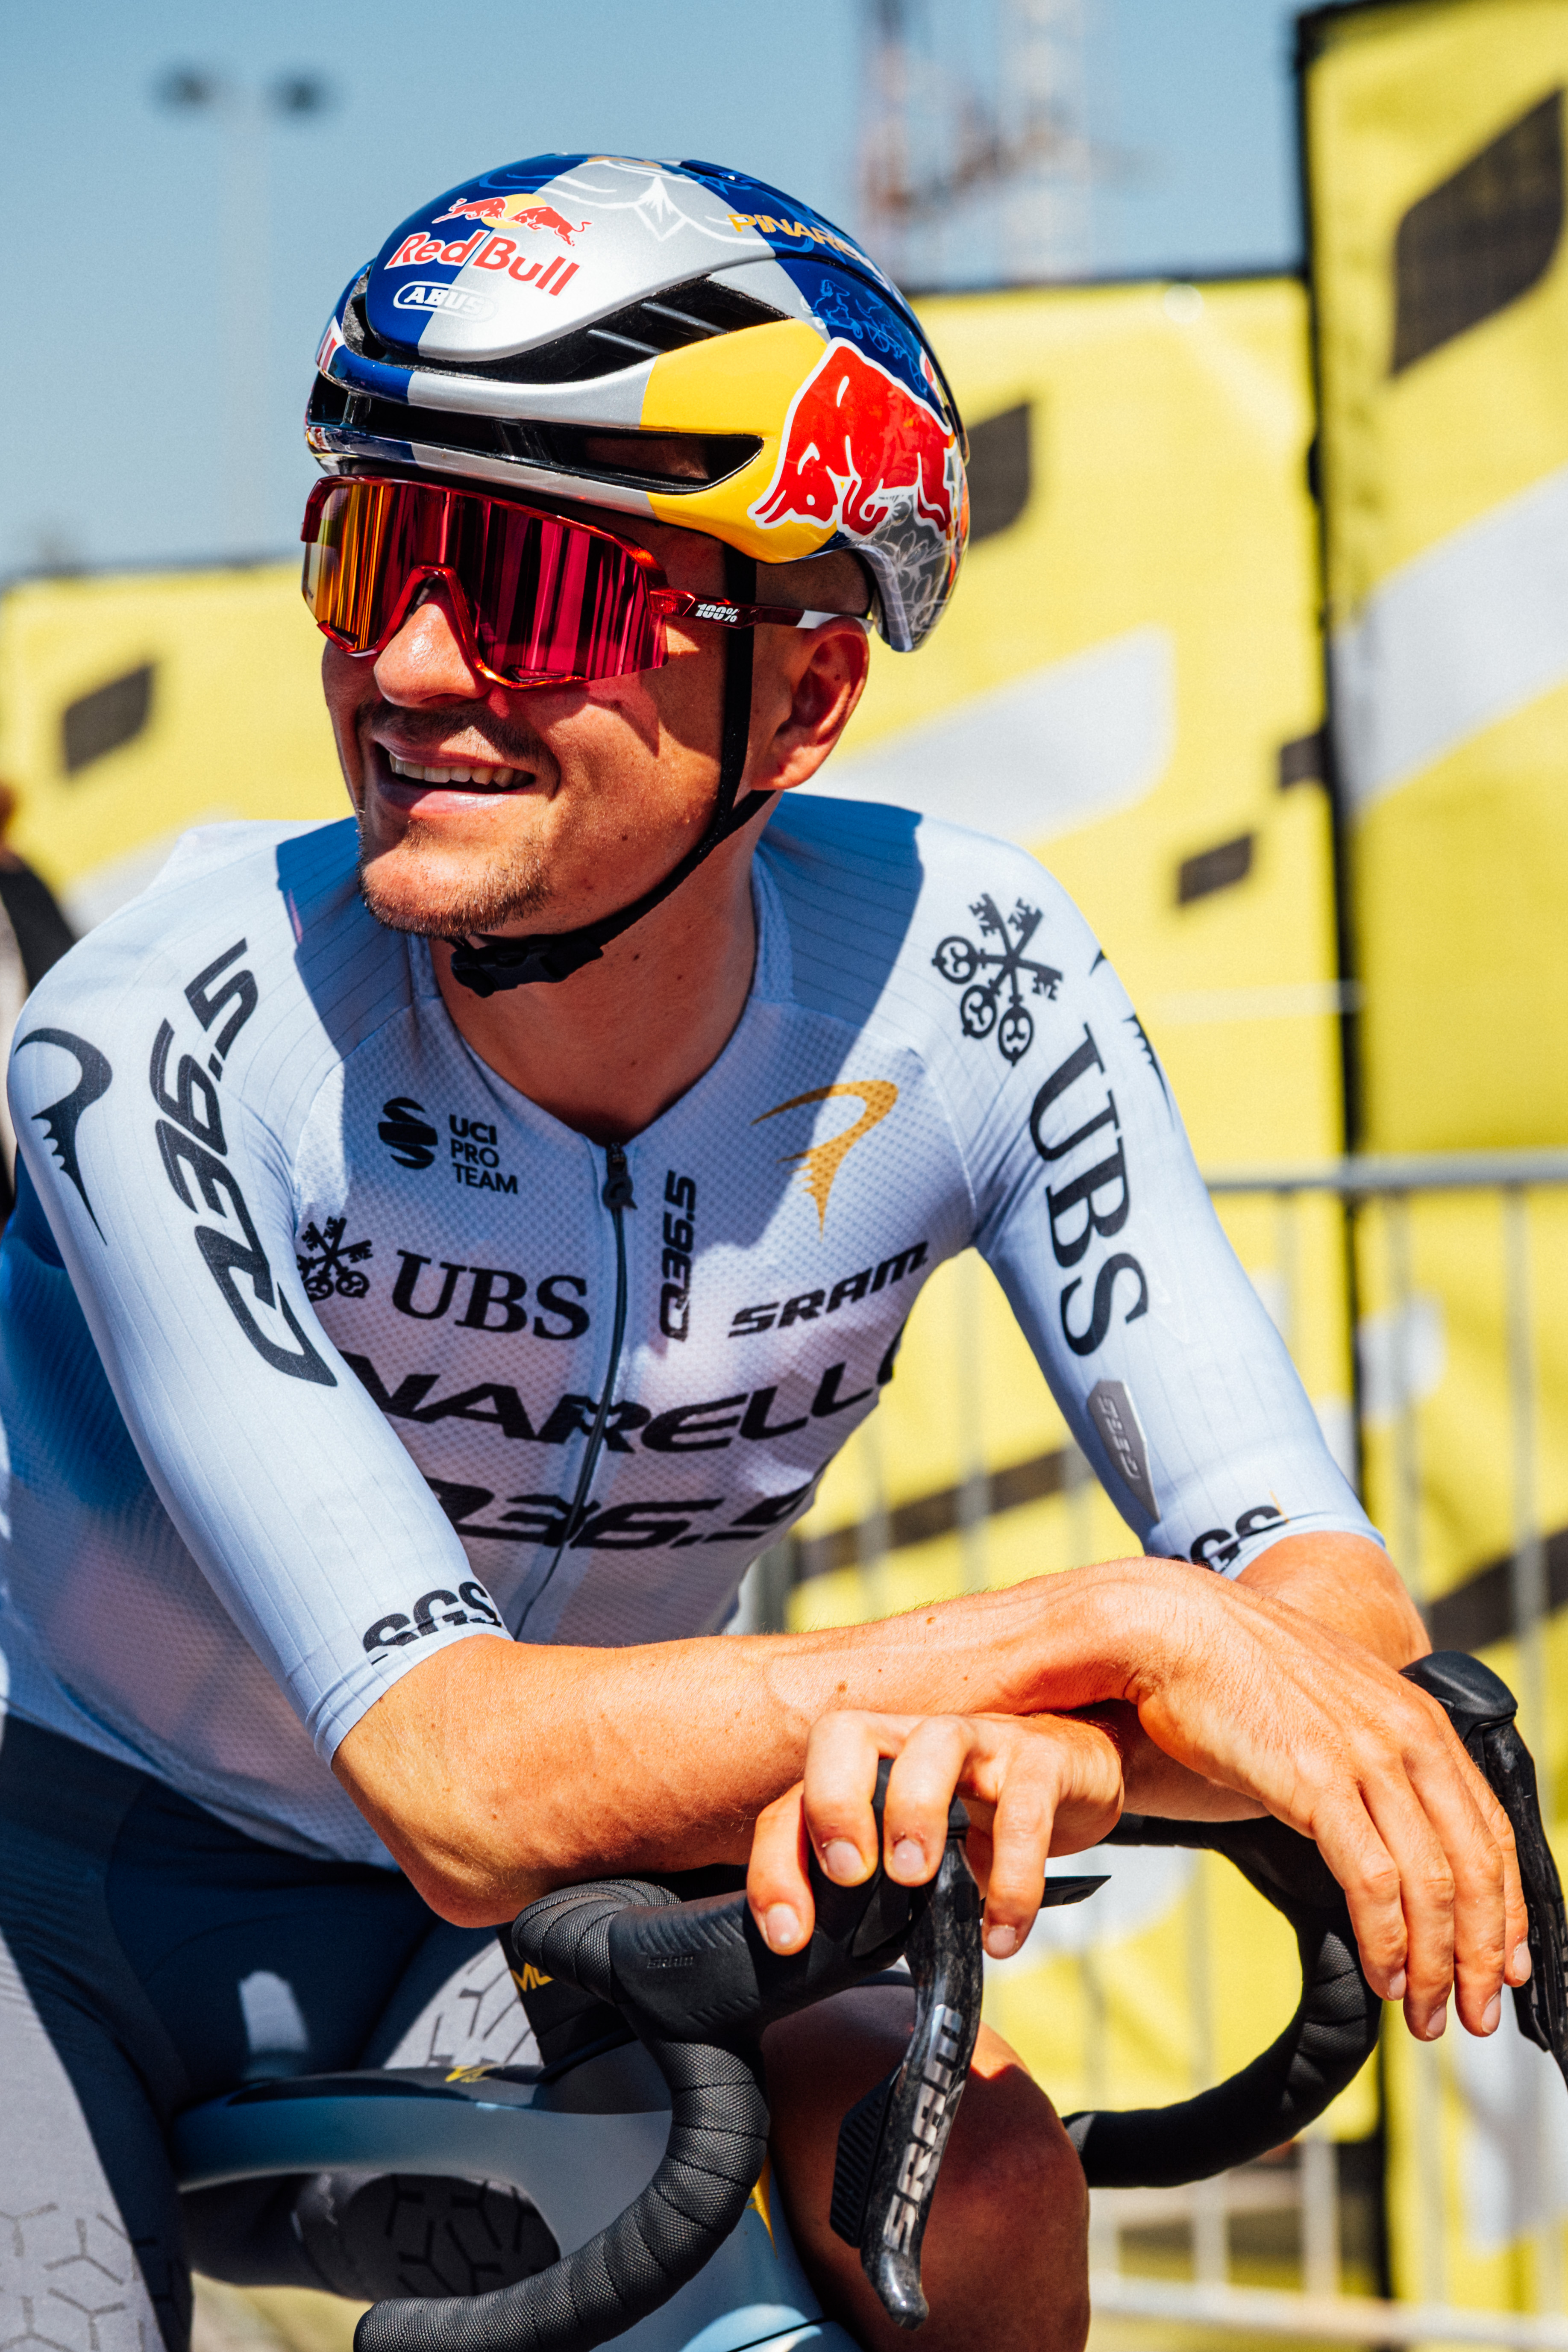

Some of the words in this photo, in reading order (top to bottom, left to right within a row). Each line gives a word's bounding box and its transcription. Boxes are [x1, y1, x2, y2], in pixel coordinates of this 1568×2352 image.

[386, 231, 488, 268] Red
[473, 236, 580, 297] Bull
[403, 286, 484, 315] ABUS
[695, 603, 740, 623] 100%
[150, 937, 338, 1387] Q36.5
[449, 1114, 497, 1146] UCI
[451, 1138, 499, 1168] PRO
[452, 1162, 518, 1195] TEAM
[1029, 1022, 1148, 1357] UBS
[659, 1169, 696, 1342] Q36.5
[728, 1241, 928, 1338] SRAM
[392, 1250, 590, 1340] UBS
[363, 1581, 502, 1653] SGS
